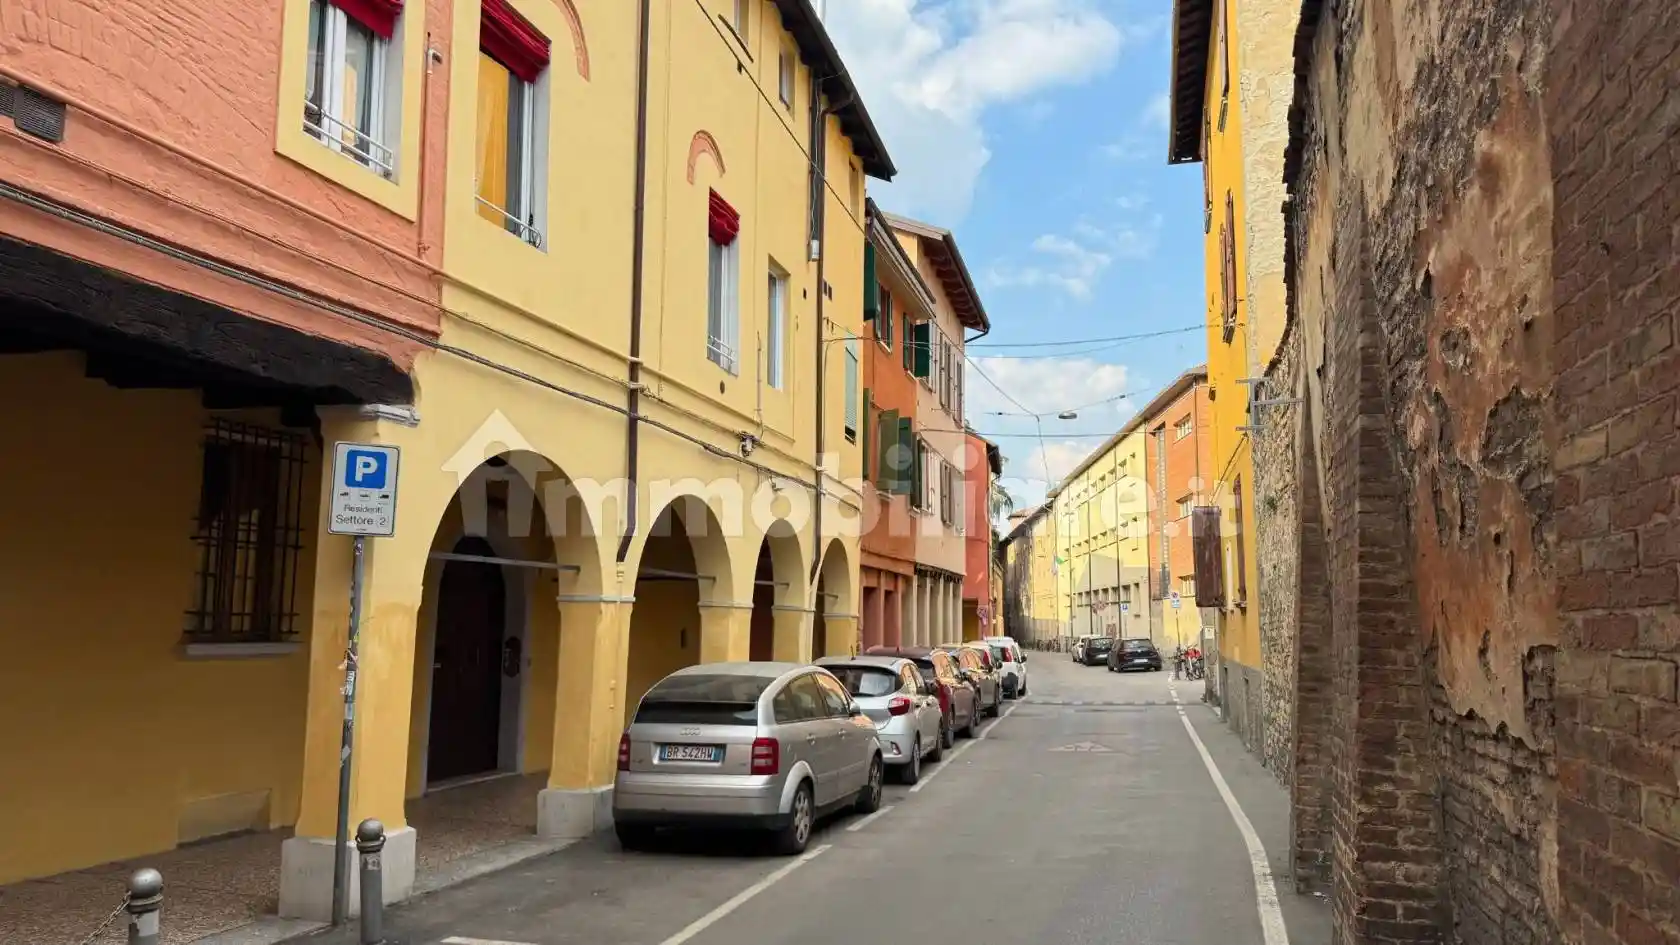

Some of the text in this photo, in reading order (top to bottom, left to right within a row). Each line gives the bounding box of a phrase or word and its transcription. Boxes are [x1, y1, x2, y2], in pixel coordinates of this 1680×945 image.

[355, 456, 378, 482] P
[343, 504, 383, 515] Residenti
[336, 514, 374, 526] Settore
